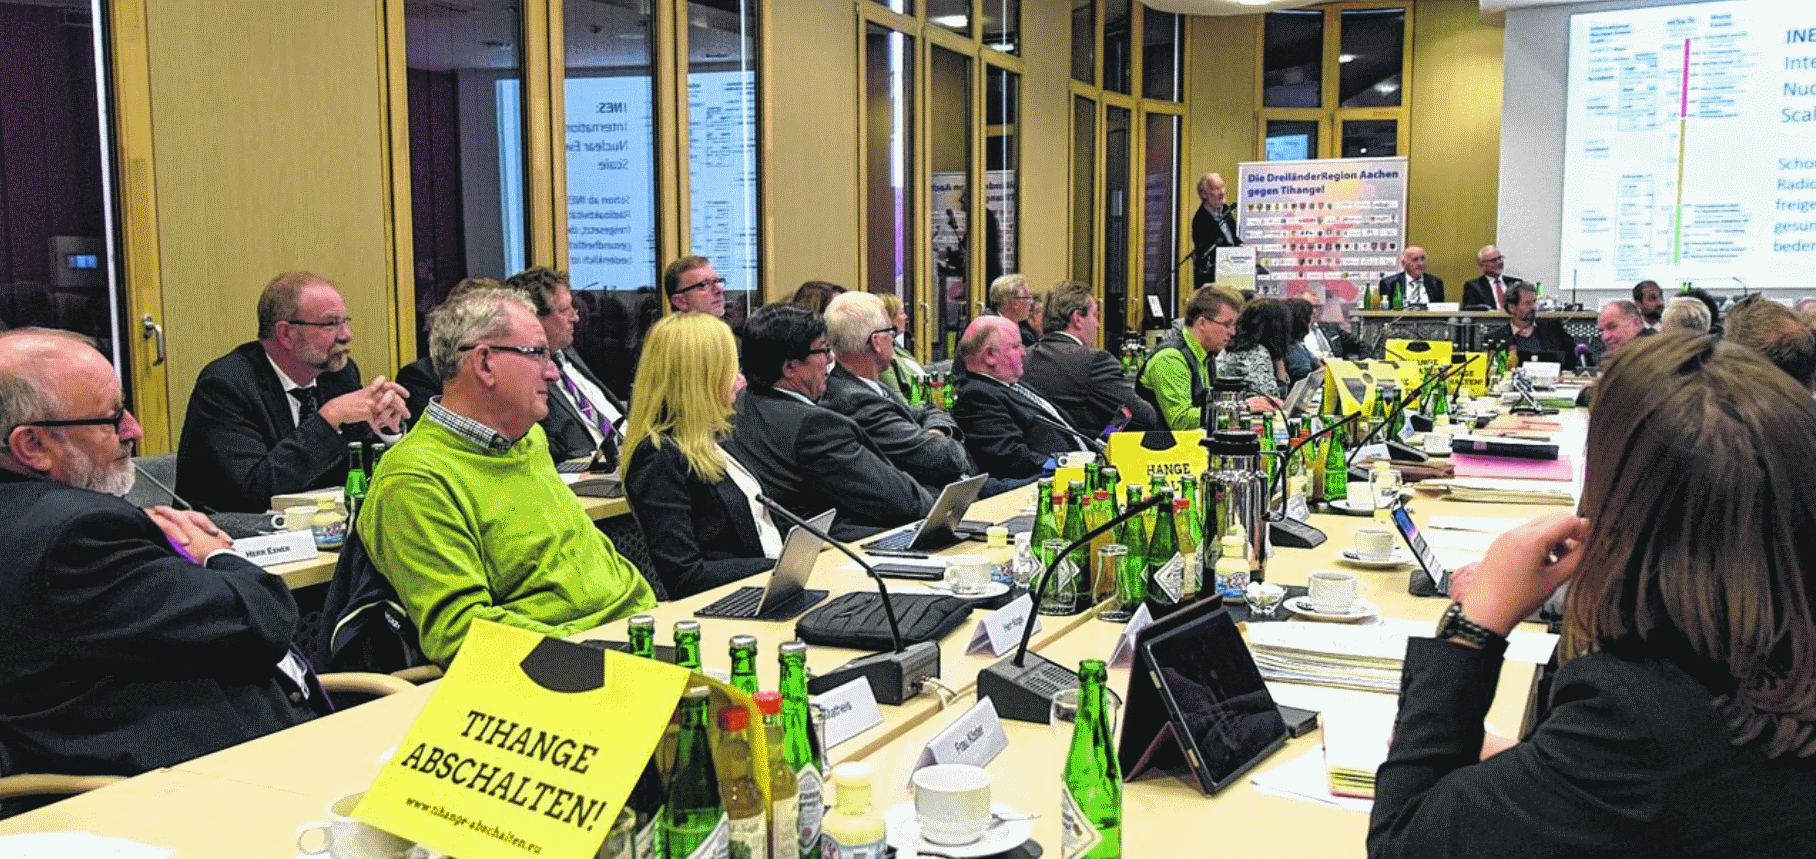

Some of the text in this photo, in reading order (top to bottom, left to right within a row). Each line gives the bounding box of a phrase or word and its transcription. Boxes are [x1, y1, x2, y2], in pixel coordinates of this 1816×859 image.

[1247, 184, 1325, 198] gegen Tihange!
[1248, 173, 1265, 183] Die
[1359, 169, 1399, 180] Aachen
[460, 709, 600, 776] TIHANGE
[400, 742, 608, 833] ABSCHALTEN!
[404, 795, 543, 856] www.tihange-abschalten.eu
